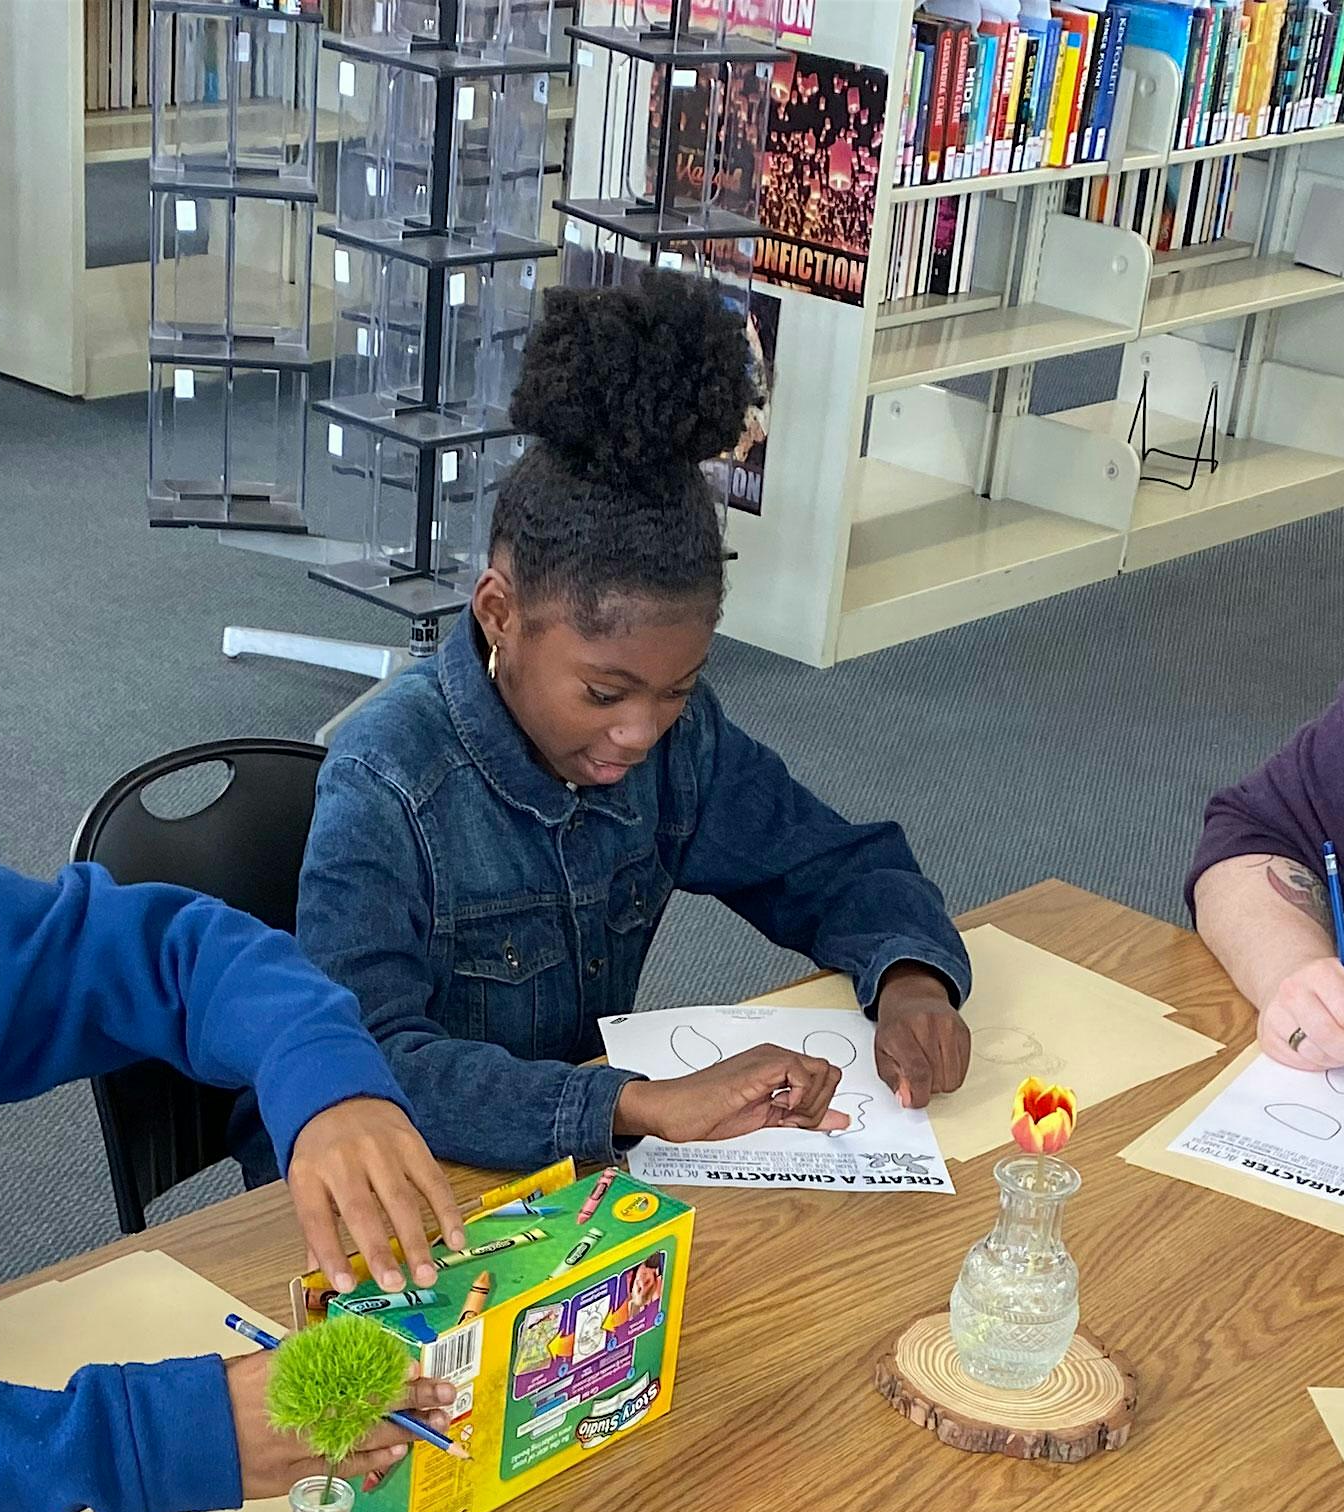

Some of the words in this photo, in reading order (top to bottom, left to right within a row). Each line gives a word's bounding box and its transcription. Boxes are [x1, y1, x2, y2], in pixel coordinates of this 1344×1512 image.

[961, 66, 976, 114] HIDE
[754, 236, 864, 294] ONFICTION
[704, 1169, 834, 1184] CHARACTER
[836, 1174, 856, 1184] A
[862, 1174, 945, 1186] CREATE
[621, 1383, 658, 1421] Story
[578, 1414, 620, 1436] Studio
